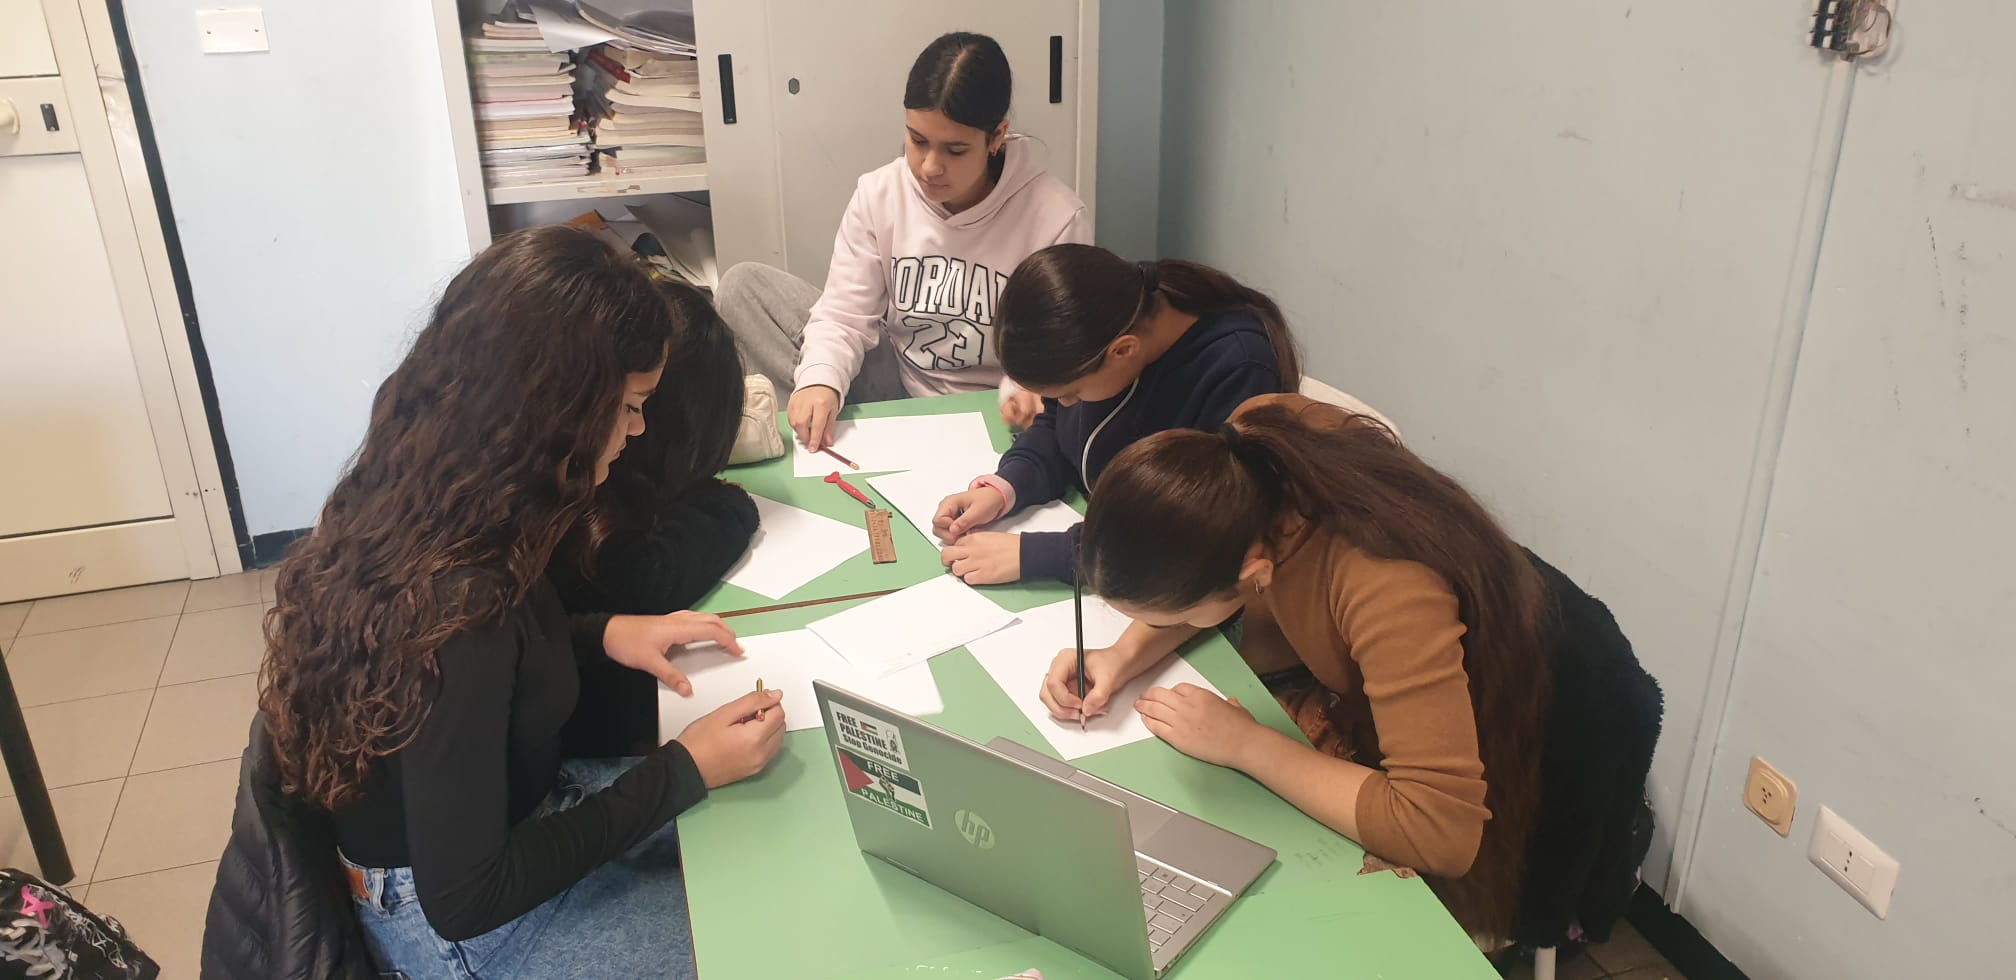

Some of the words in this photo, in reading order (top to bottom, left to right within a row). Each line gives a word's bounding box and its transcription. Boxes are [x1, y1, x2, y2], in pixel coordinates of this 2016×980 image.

[891, 255, 1008, 326] ORDA
[902, 316, 984, 370] 23
[836, 712, 858, 728] FREE
[839, 723, 888, 750] PALESTINE
[843, 734, 863, 750] Stop
[863, 741, 903, 765] Genocide
[866, 761, 900, 782] FREE
[861, 788, 923, 821] PALESTINE
[960, 811, 991, 848] hp
